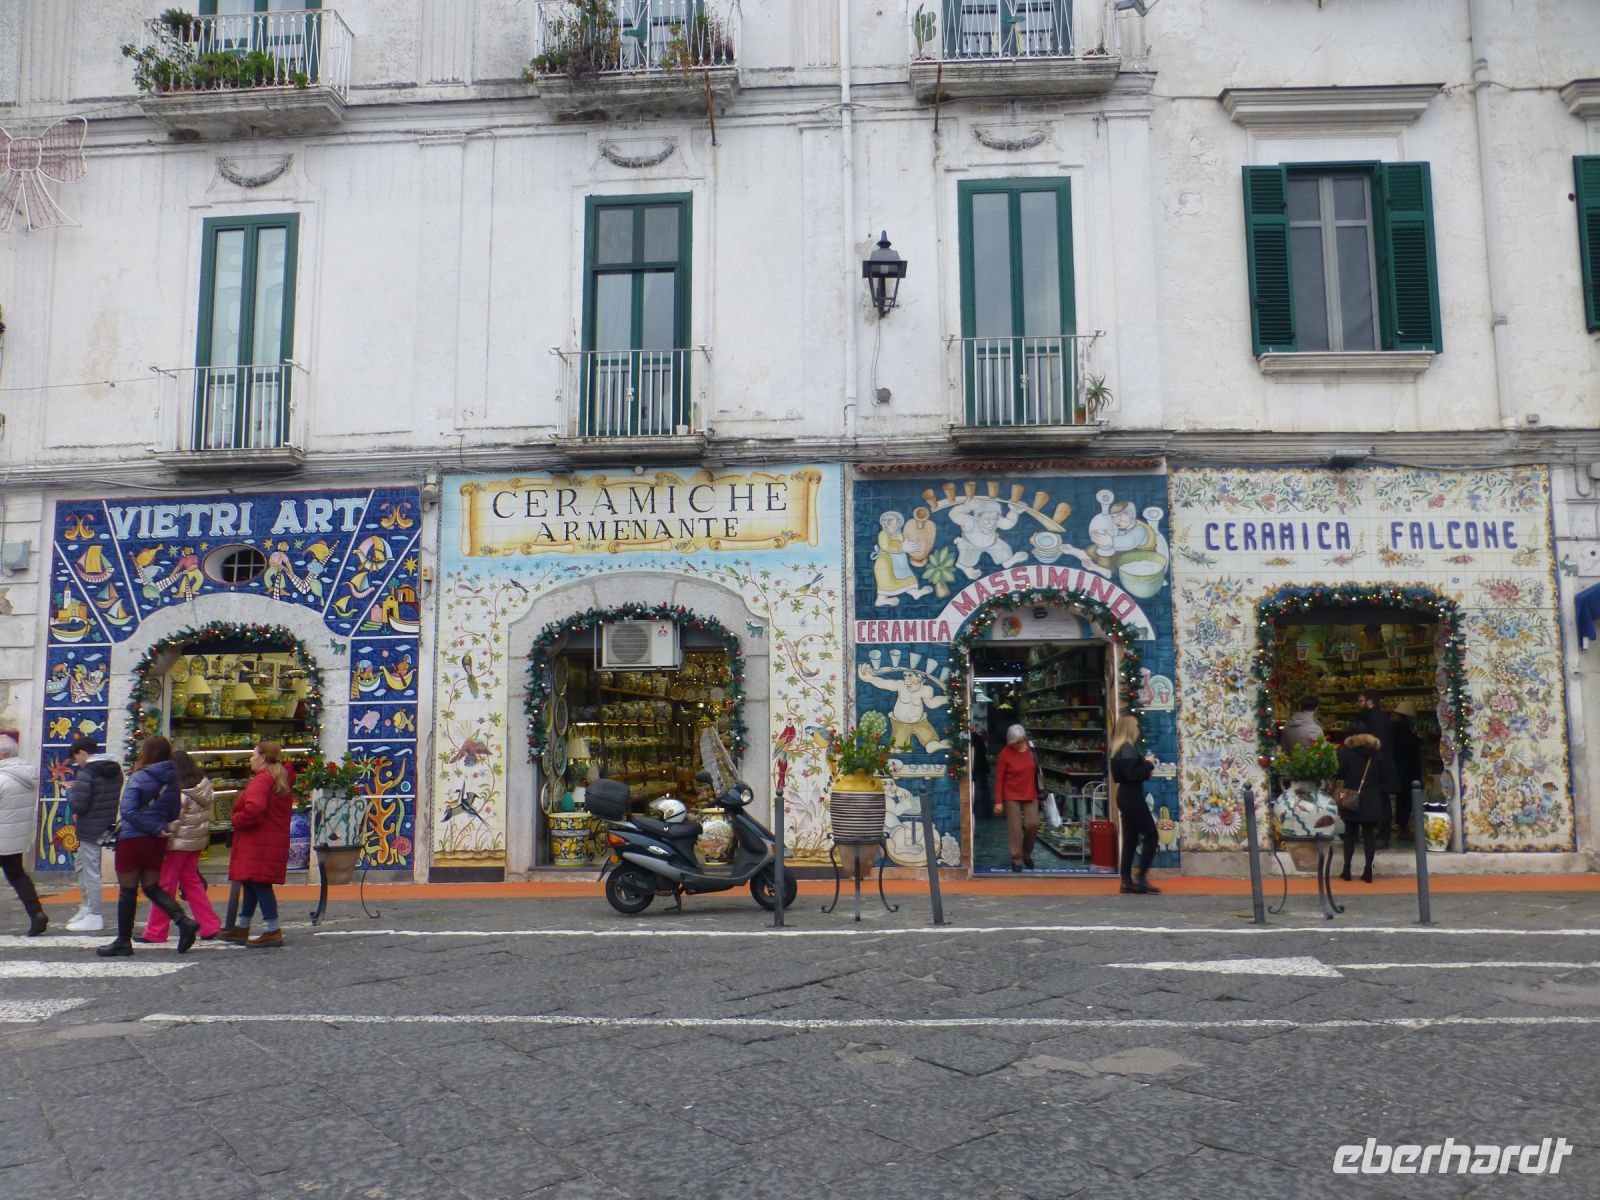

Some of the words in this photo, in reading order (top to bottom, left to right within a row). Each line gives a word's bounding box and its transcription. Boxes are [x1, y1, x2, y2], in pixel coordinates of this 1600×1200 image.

[491, 481, 788, 518] CERAMICHE
[108, 502, 253, 540] VIETRI
[270, 497, 367, 533] ART
[534, 516, 739, 542] ARMENANTE
[1204, 521, 1350, 550] CERAMICA
[1390, 520, 1518, 549] FALCONE
[856, 619, 951, 642] CERAMICA
[950, 565, 1137, 620] MASSIMINO
